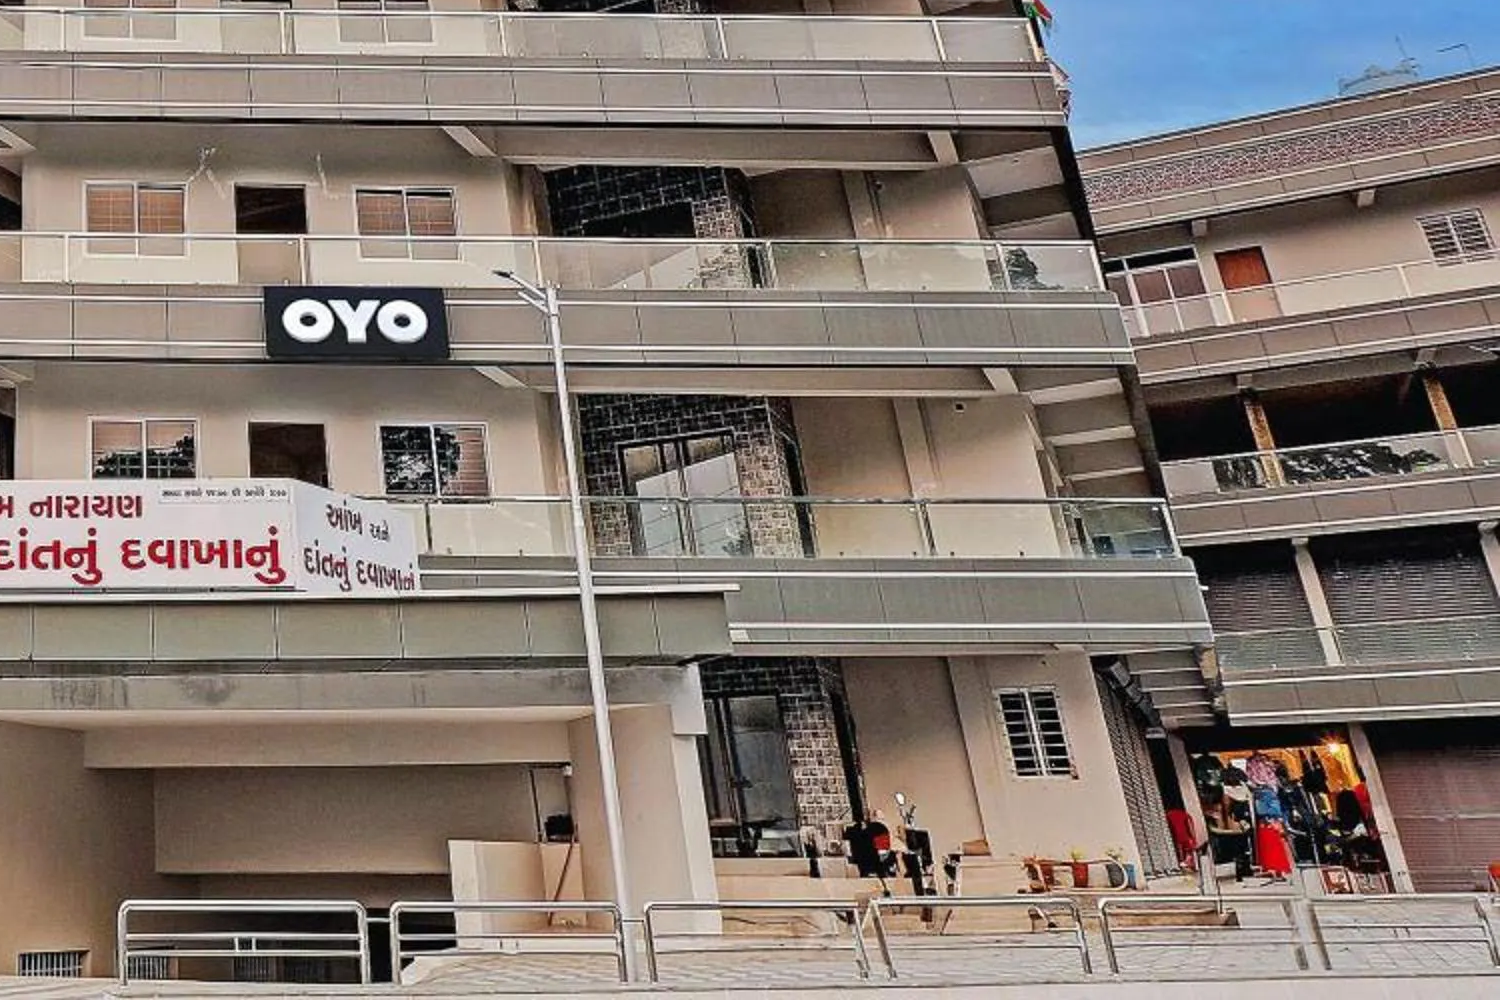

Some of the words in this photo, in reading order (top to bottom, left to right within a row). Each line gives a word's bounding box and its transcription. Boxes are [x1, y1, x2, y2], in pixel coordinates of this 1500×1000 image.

[282, 298, 429, 344] OYO
[29, 495, 142, 519] નારાયણ
[326, 499, 363, 536] આંખ
[120, 525, 287, 585] દવાખાનું
[303, 539, 352, 592] દાંતનું
